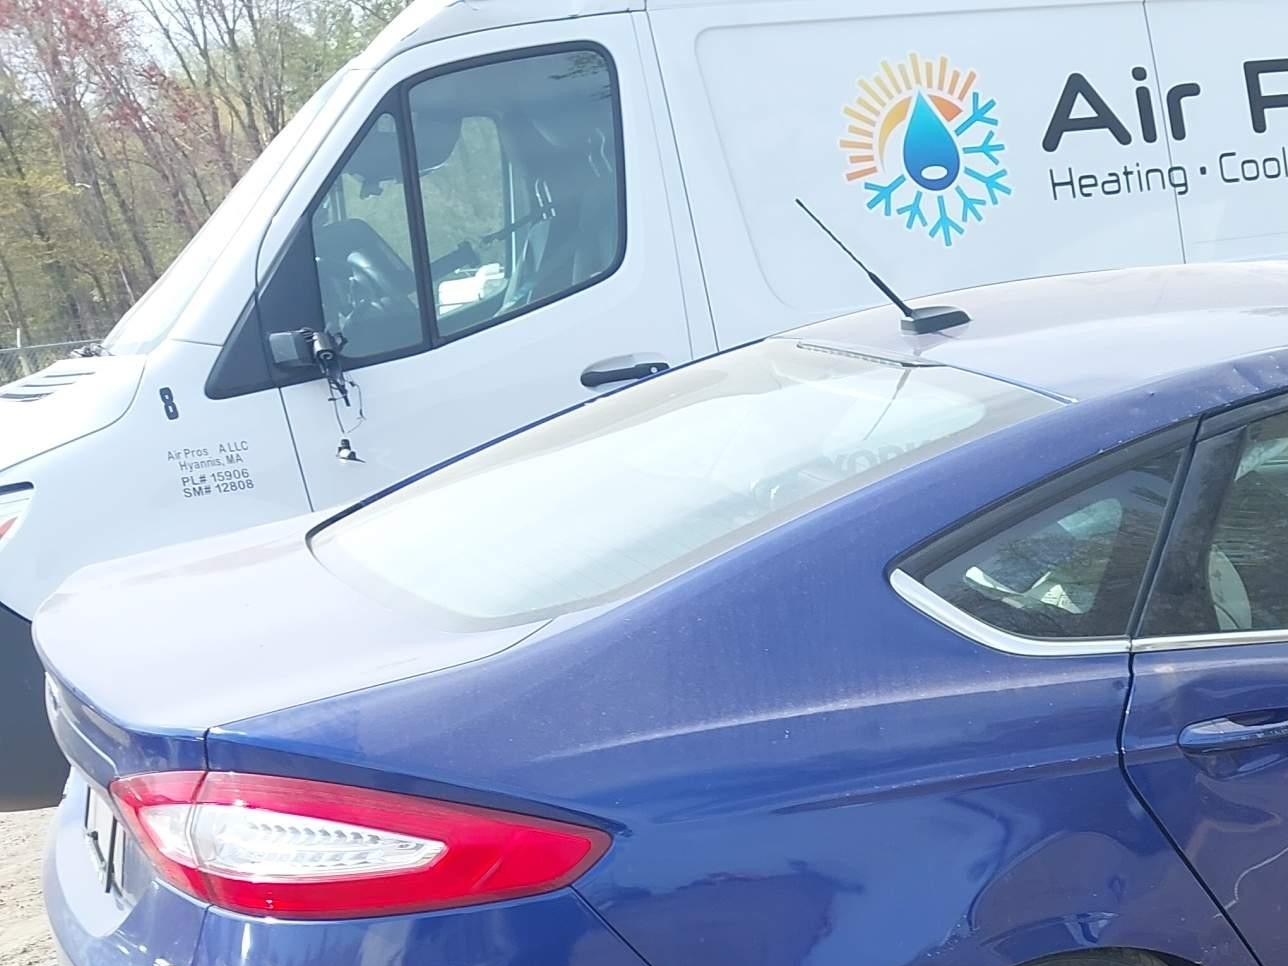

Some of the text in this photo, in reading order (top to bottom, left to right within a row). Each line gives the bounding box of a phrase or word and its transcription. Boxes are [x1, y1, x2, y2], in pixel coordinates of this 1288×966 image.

[1043, 66, 1201, 152] Air
[1050, 163, 1189, 200] Heating
[227, 440, 249, 452] LLC
[226, 453, 244, 464] MA
[181, 468, 250, 487] PL# 15906
[183, 479, 254, 498] SM# 12808
